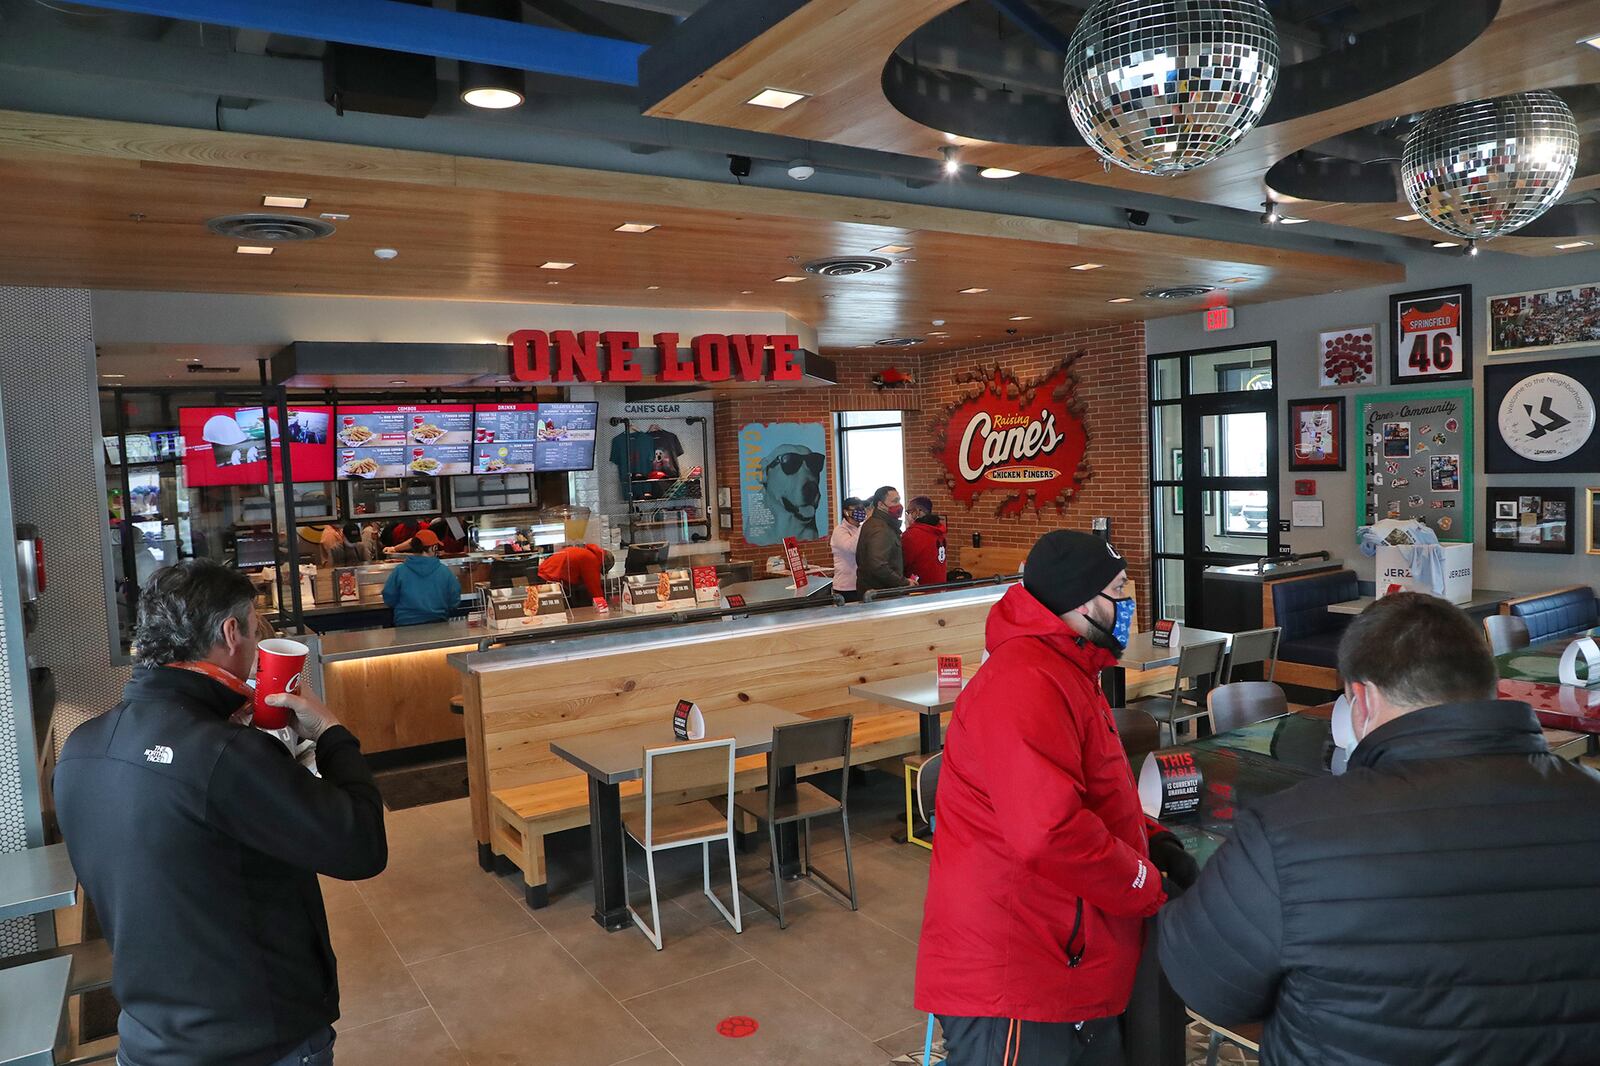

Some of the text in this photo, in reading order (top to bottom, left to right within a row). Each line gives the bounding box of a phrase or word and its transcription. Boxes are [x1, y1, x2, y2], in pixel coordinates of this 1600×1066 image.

[1207, 309, 1229, 329] EXIT
[1410, 317, 1451, 329] SPRINGFIELD
[507, 329, 802, 382] ONE LOVE
[1408, 332, 1453, 373] 46
[1507, 386, 1526, 414] Welcome
[1533, 377, 1546, 385] the
[625, 405, 655, 413] CANE'S
[1400, 401, 1457, 418] Community
[993, 413, 1030, 428] Raising
[1315, 432, 1322, 443] 5
[958, 409, 1064, 482] Cane's
[992, 470, 1053, 479] CHICKEN FINGERS
[1384, 568, 1412, 578] JERZ
[1449, 568, 1471, 579] JERZEES
[1160, 752, 1194, 768] THIS
[1163, 766, 1198, 779] TABLE
[1166, 780, 1198, 790] IS CURRENTLY
[1168, 786, 1198, 797] UNAVAILABLE
